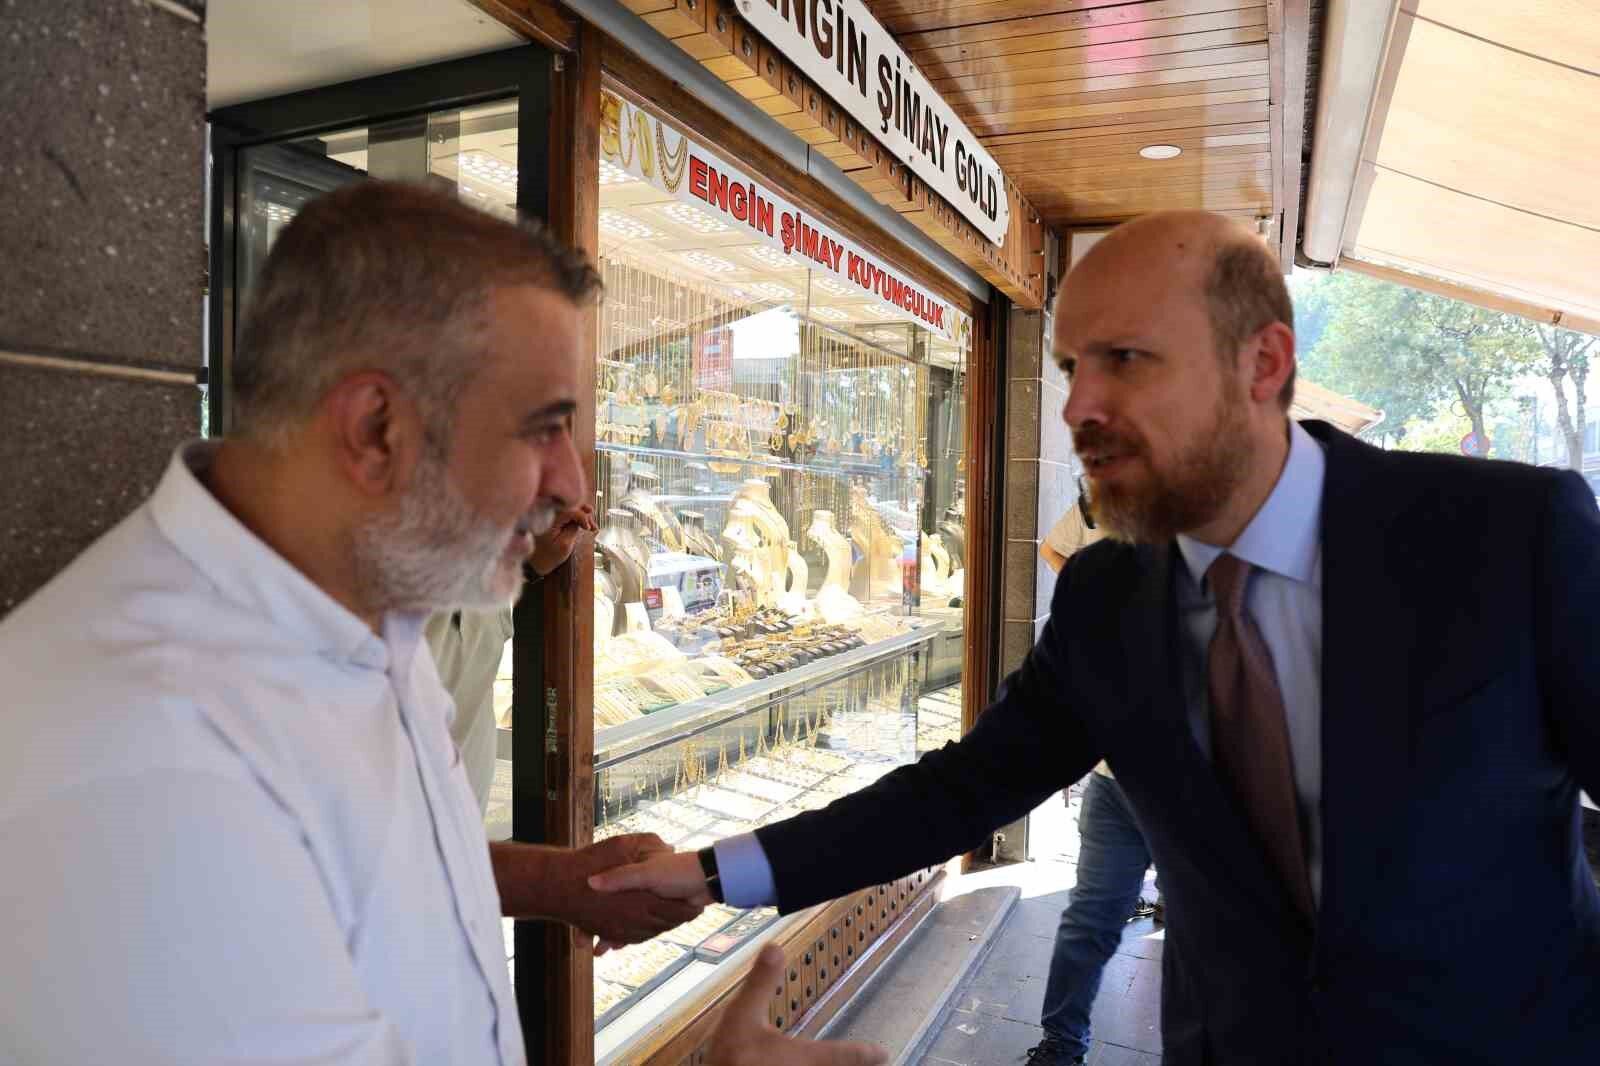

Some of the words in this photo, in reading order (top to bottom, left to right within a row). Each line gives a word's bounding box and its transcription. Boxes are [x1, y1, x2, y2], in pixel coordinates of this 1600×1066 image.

[766, 0, 867, 98] GİN
[877, 54, 948, 173] ŞİMAY
[955, 140, 997, 222] GOLD
[689, 154, 774, 238] ENGİN
[780, 211, 843, 273] ŞİMAY
[847, 251, 944, 330] KUYUMCULUK
